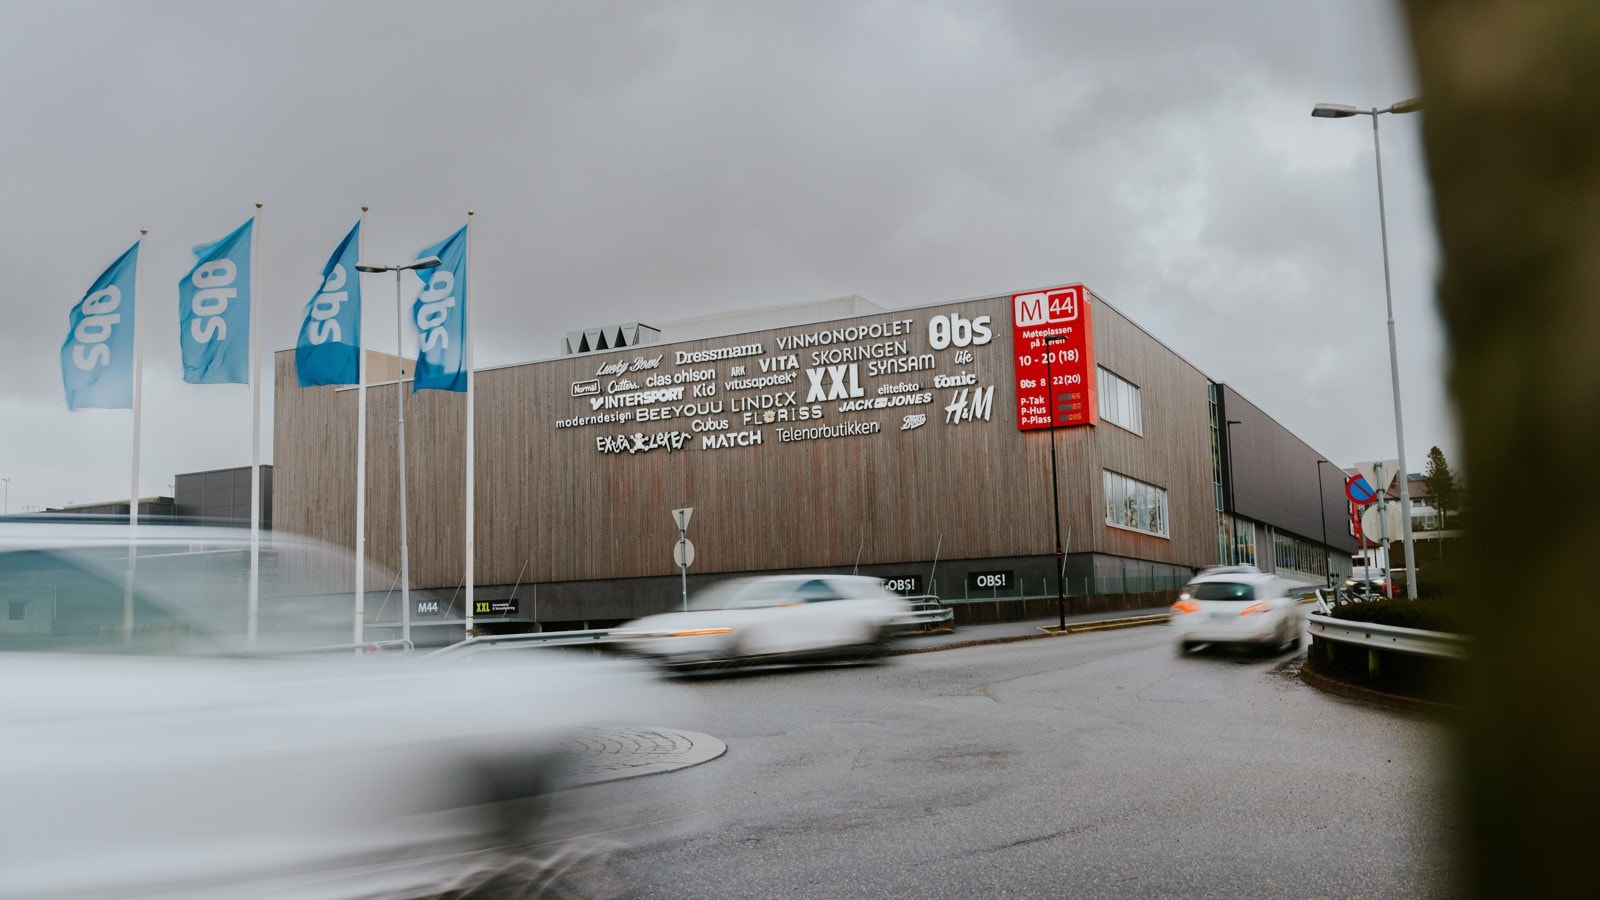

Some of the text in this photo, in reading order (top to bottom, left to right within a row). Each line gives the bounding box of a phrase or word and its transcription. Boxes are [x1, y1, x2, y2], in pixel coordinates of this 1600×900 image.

[776, 319, 913, 350] VINMONOPOLET
[1022, 326, 1073, 339] Møteplassen
[1030, 338, 1040, 349] på
[675, 343, 763, 365] Dressmann
[812, 340, 907, 366] SKORINGEN
[954, 350, 973, 364] life
[1019, 355, 1032, 366] 10
[1041, 352, 1056, 364] 20
[1058, 348, 1079, 364] (18)
[630, 354, 664, 372] Bowl
[759, 354, 799, 373] VITA
[868, 354, 935, 376] SYNSAM
[646, 368, 716, 387] clas ohlson
[731, 366, 746, 377] ARK
[573, 382, 597, 394] Normal
[693, 382, 716, 398] Kid
[806, 363, 865, 403] XXL
[878, 382, 919, 395] elitefoto
[1040, 378, 1046, 387] 8
[605, 387, 684, 409] INTERSPORT
[731, 391, 796, 412] LINDEX
[945, 385, 994, 424] H&M
[1020, 395, 1045, 406] P-Tak
[636, 400, 723, 421] BEEYOUU
[1021, 406, 1046, 416] P-Hus
[556, 411, 631, 428] moderndesign
[692, 417, 729, 432] Cubus
[1021, 415, 1052, 425] P-Plass
[776, 421, 879, 442] Telenorbutikken
[702, 430, 762, 450] MATCH
[888, 578, 915, 591] OBS!
[977, 573, 1006, 587] OBS!
[418, 602, 438, 613] M44
[476, 602, 490, 613] XXL
